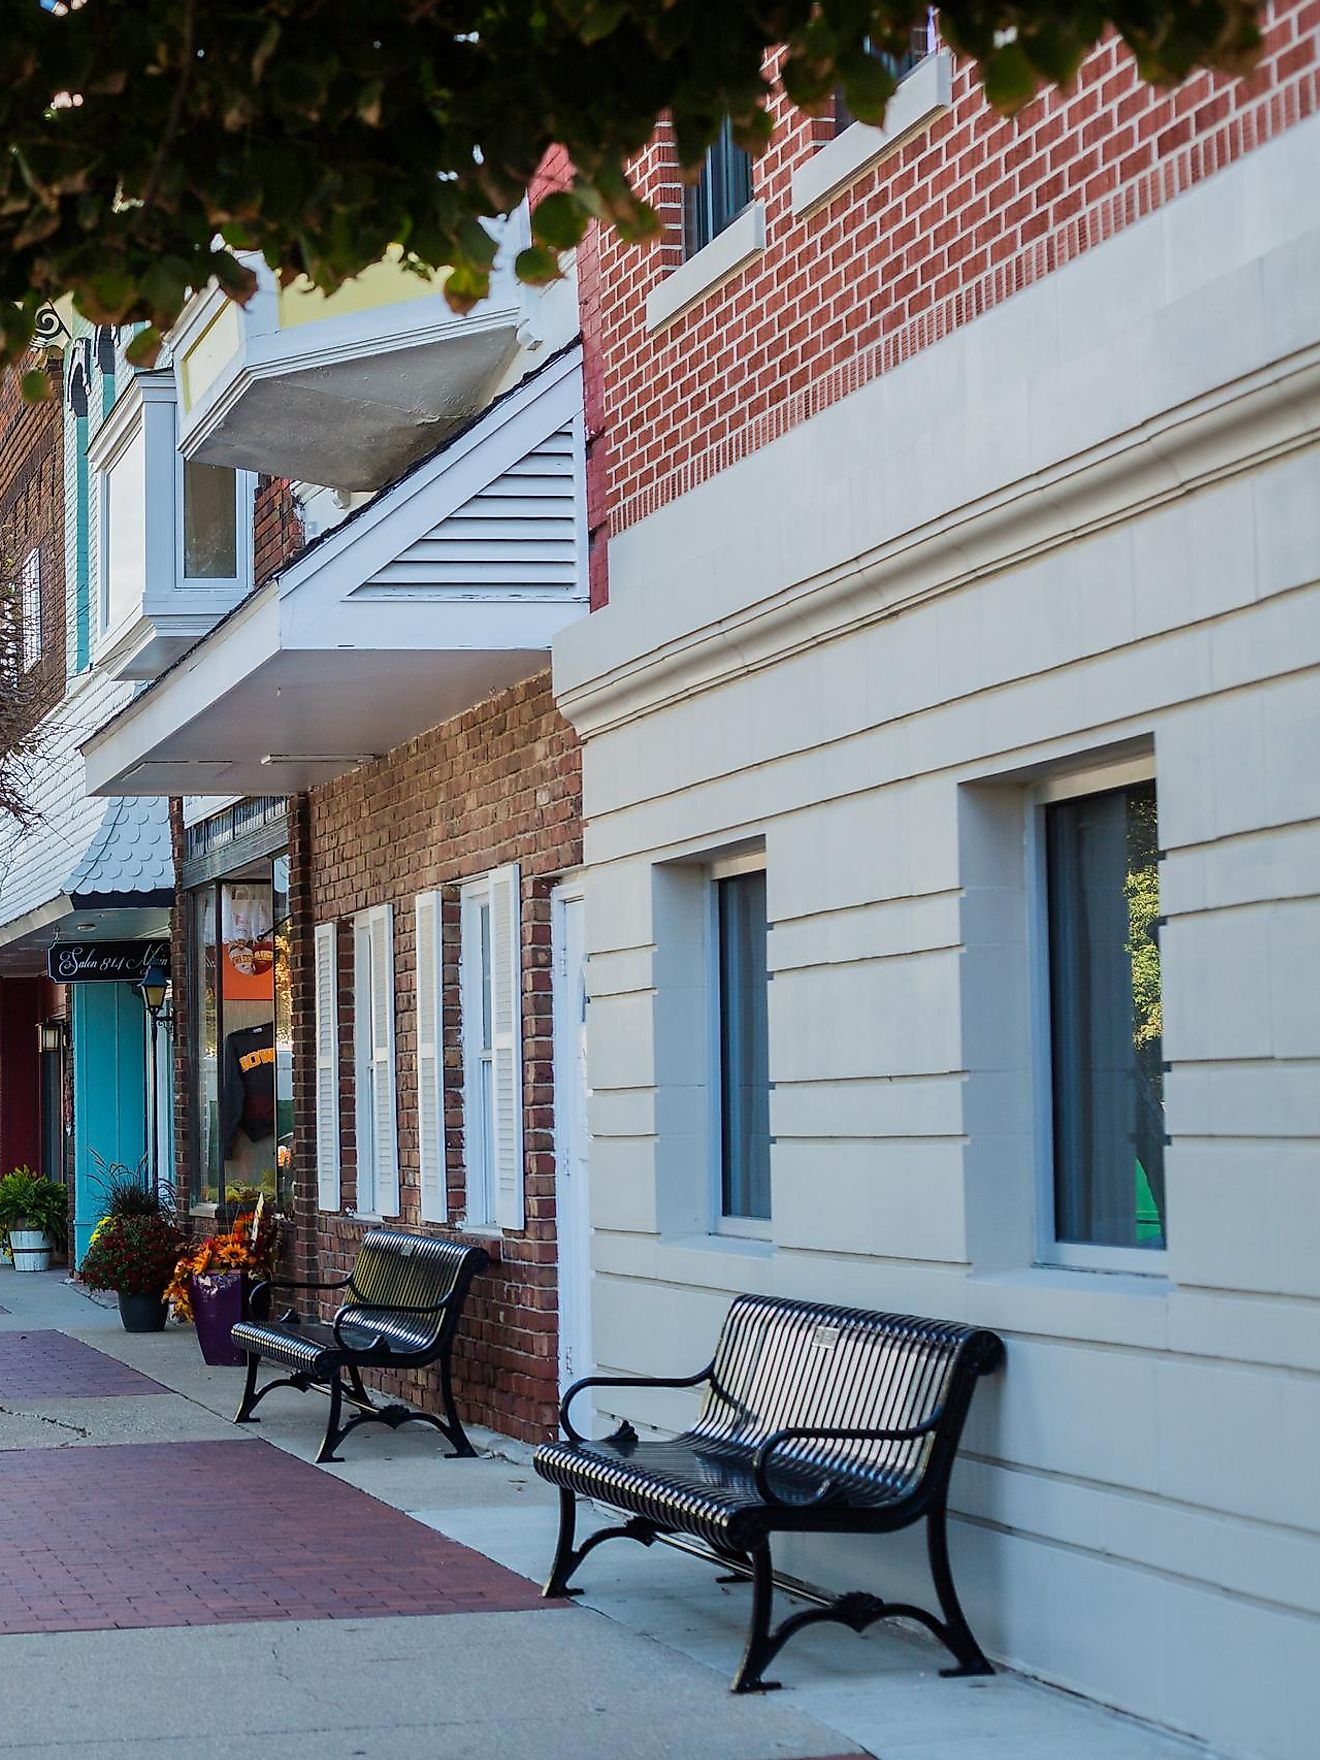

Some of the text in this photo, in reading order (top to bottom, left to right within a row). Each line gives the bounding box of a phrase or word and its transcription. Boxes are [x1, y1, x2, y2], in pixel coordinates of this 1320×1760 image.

[59, 944, 169, 976] Salon 814 Min
